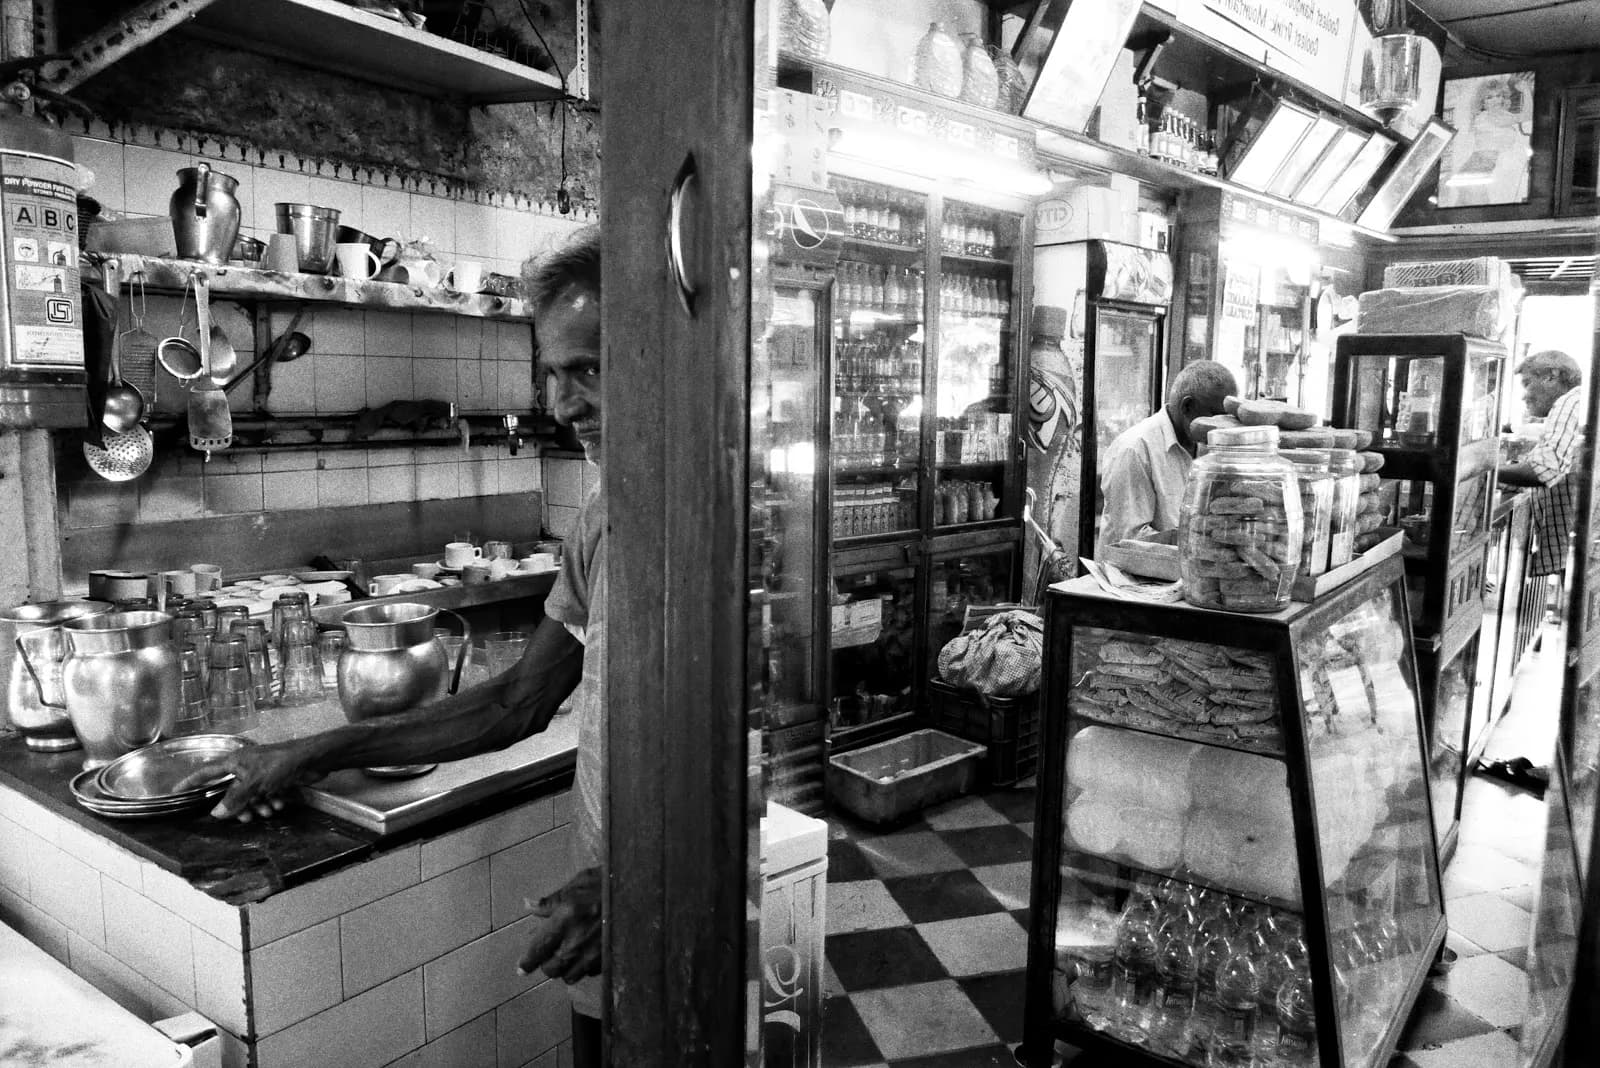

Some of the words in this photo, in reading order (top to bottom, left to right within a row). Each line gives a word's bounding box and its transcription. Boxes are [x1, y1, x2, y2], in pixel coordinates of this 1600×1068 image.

[4, 177, 20, 186] DRY
[21, 177, 53, 191] POWDER
[17, 206, 33, 224] A
[45, 209, 57, 226] B
[66, 214, 74, 231] C
